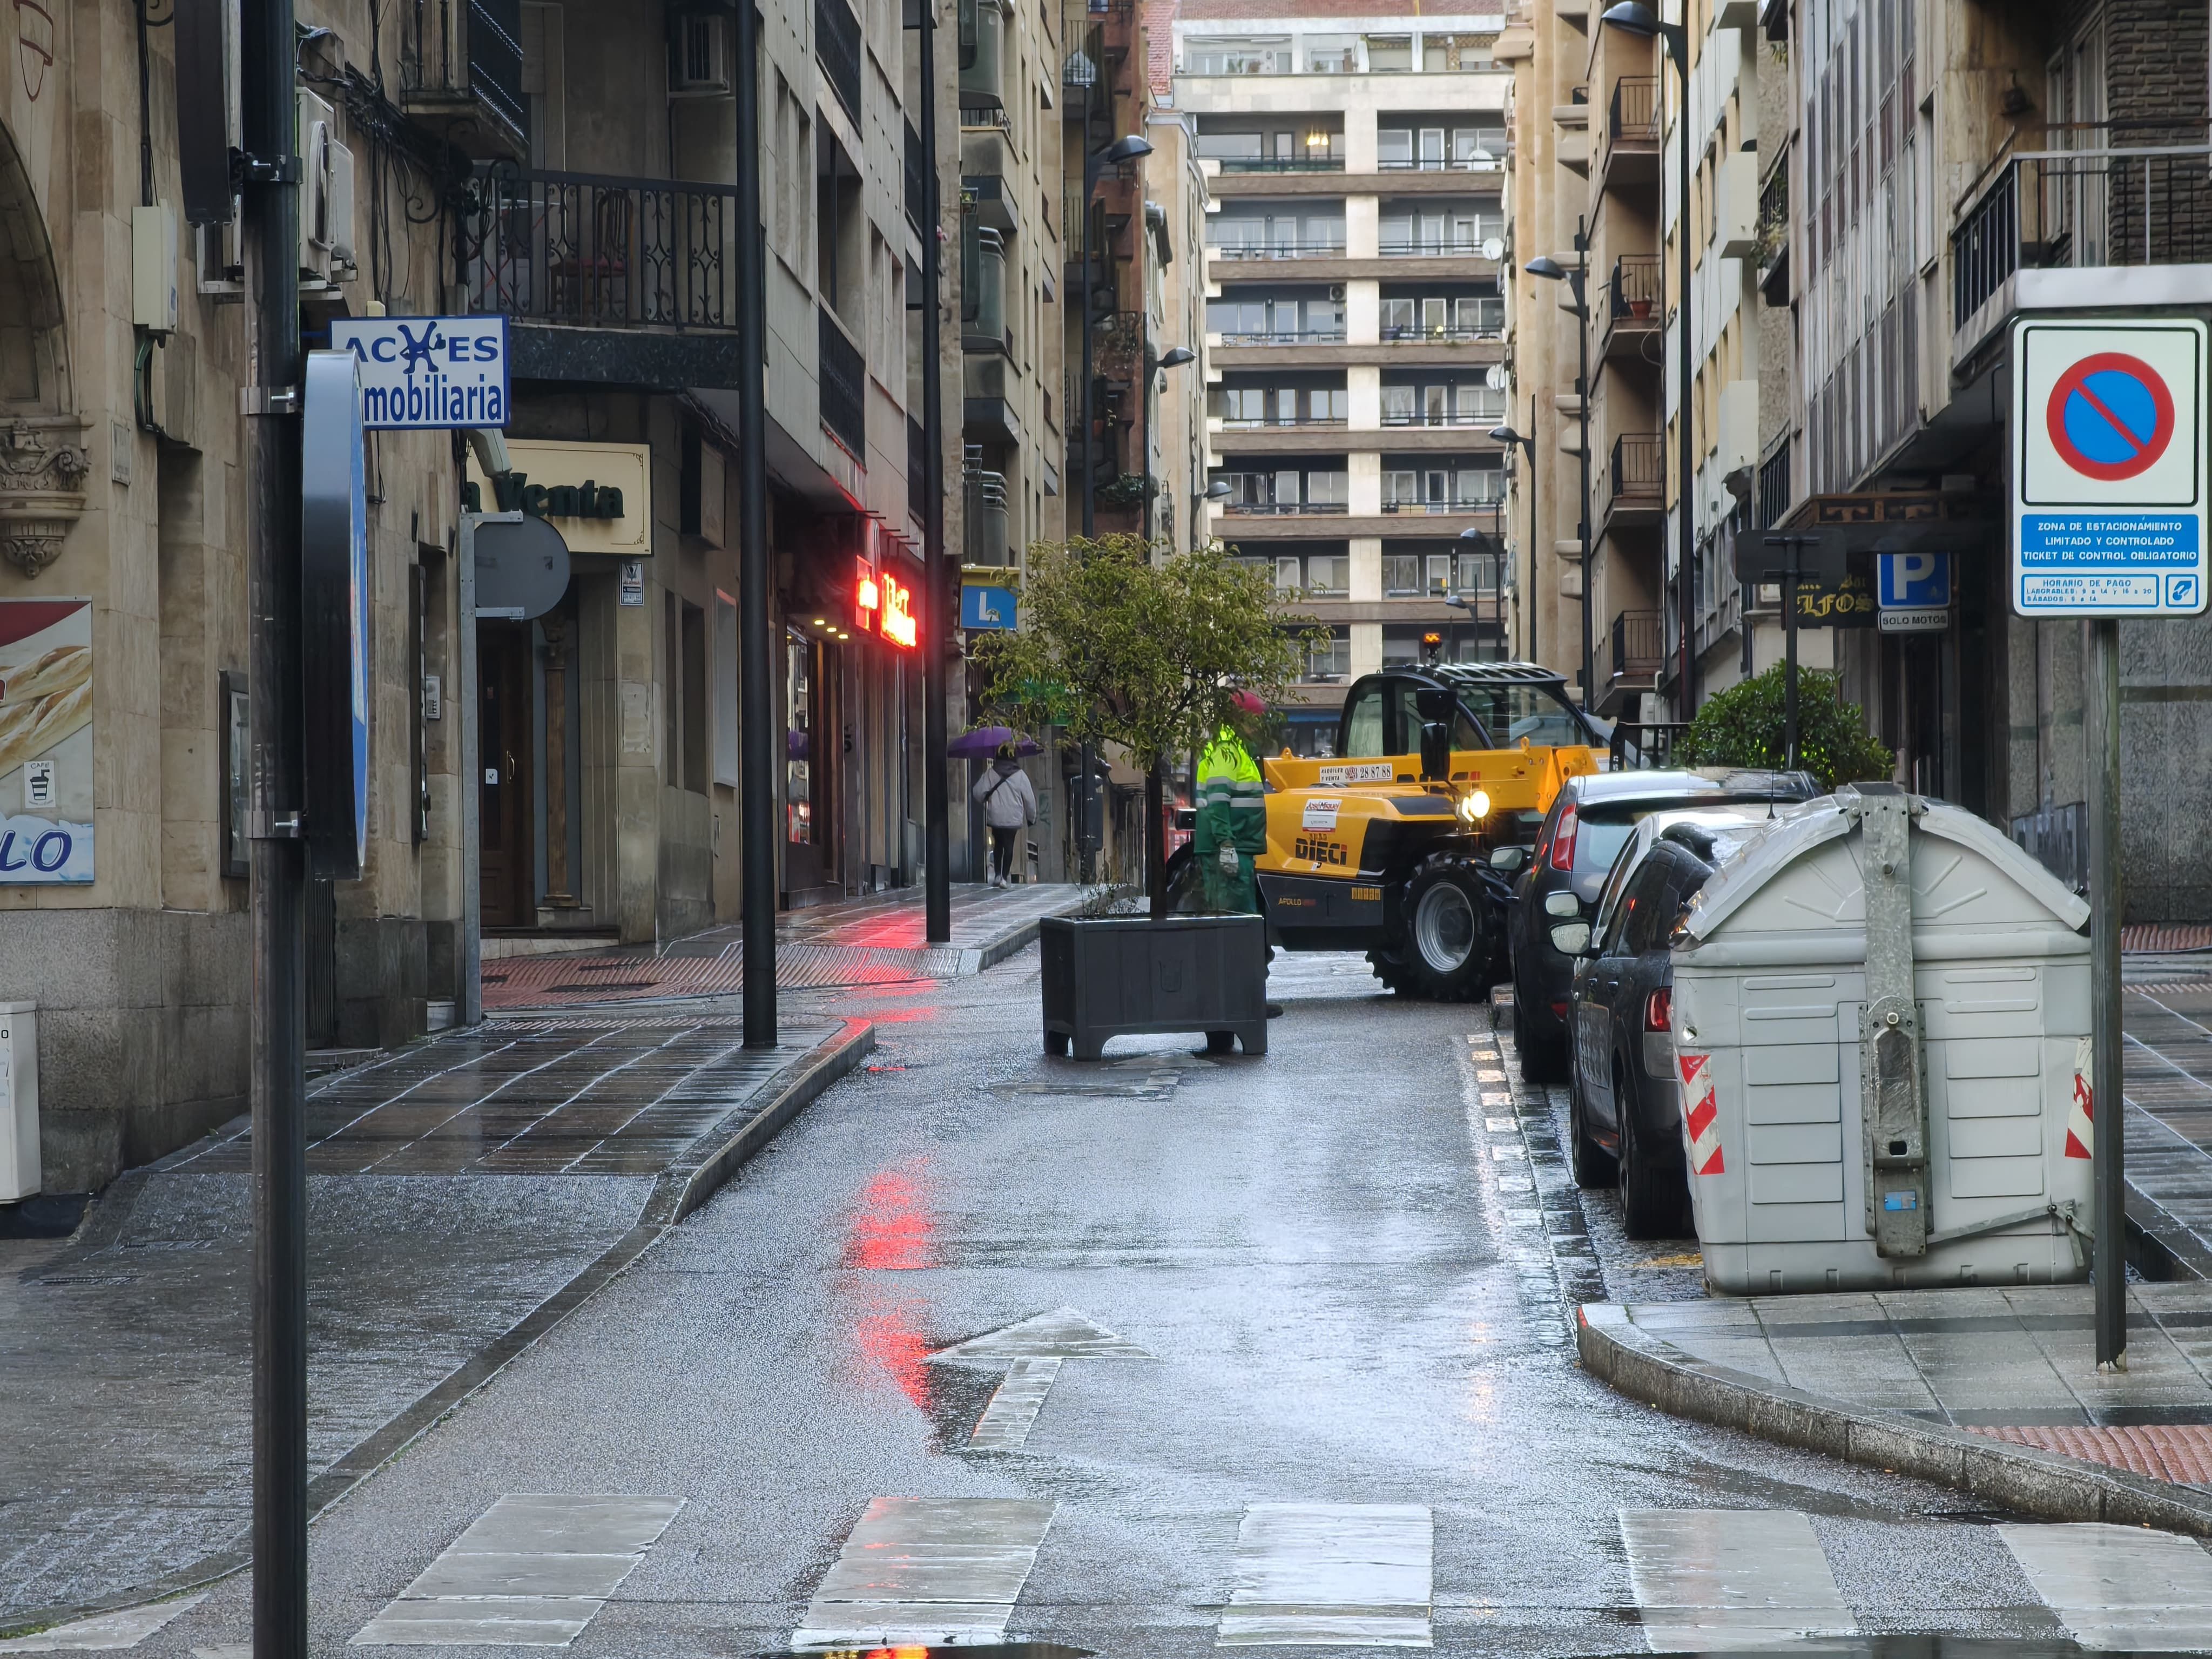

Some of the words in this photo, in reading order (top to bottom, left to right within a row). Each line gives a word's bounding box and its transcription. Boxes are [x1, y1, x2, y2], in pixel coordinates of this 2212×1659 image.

[364, 373, 502, 421] mobiliaria
[490, 472, 625, 518] Venta
[2038, 522, 2066, 531] ZONA
[2069, 522, 2082, 531] DE
[2086, 522, 2182, 531] ESTACIONAMIENTO
[2045, 537, 2091, 545] LIMITADO
[2096, 537, 2102, 545] Y
[2106, 537, 2174, 545] CONTROLADO
[2024, 551, 2058, 560] TICKET
[2062, 551, 2074, 560] DE
[2079, 551, 2126, 560] CONTROL
[2130, 551, 2197, 561] OBLIGATORIO
[1893, 554, 1936, 600] P
[1797, 594, 1874, 617] LFOS
[1883, 617, 1909, 625] SOLO
[1912, 615, 1947, 624] MOTOS
[1360, 767, 1368, 778] 28
[1371, 766, 1379, 778] 87
[1382, 765, 1391, 777] 88
[0, 830, 72, 872] LO
[1279, 898, 1301, 906] APOLLO
